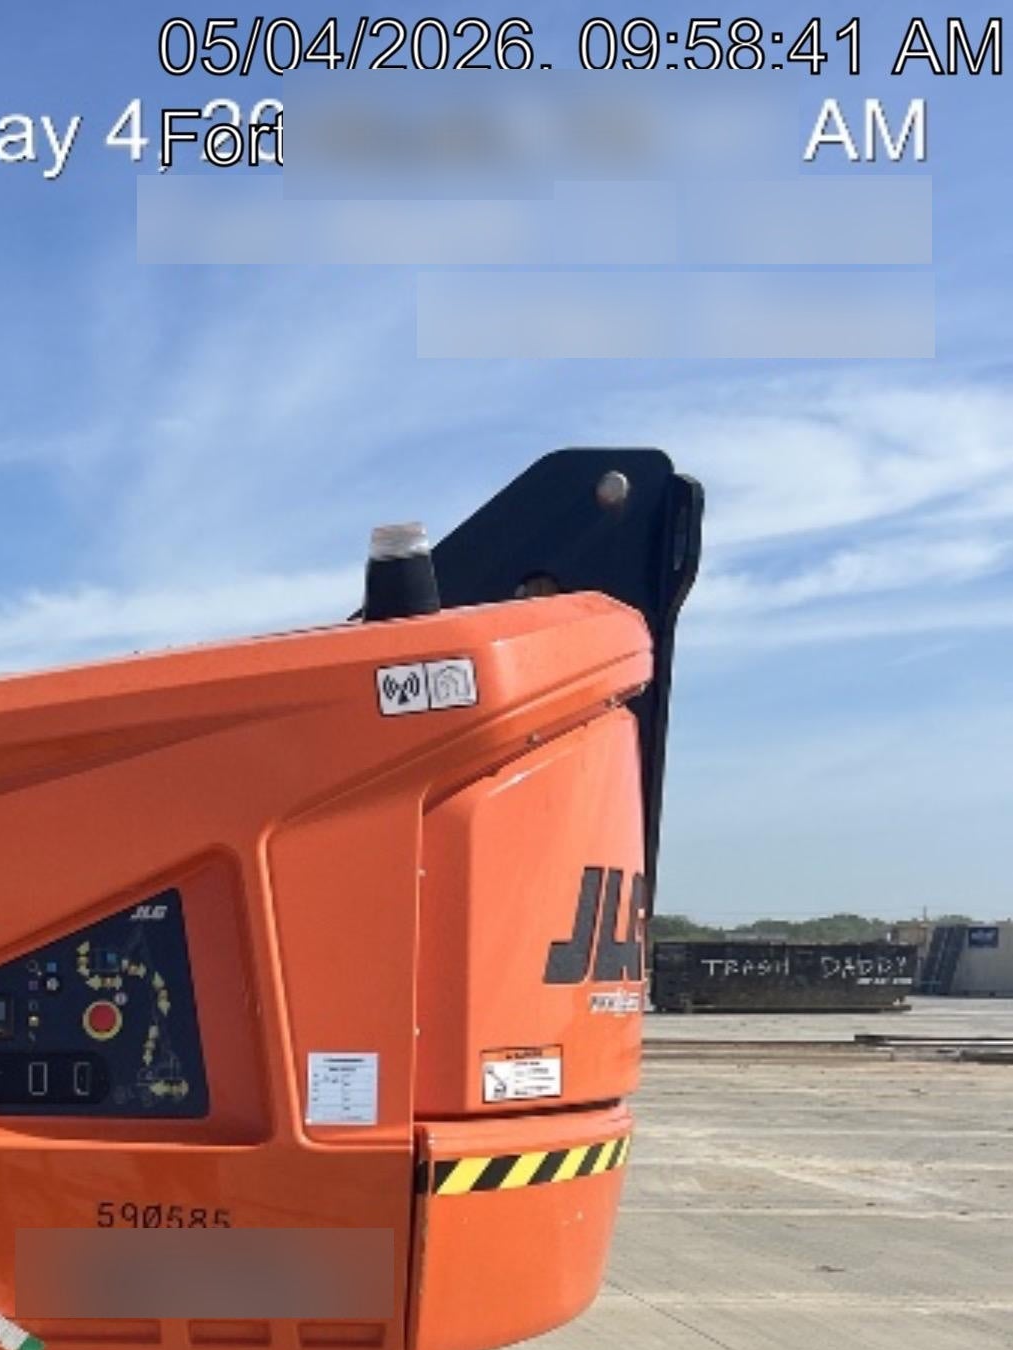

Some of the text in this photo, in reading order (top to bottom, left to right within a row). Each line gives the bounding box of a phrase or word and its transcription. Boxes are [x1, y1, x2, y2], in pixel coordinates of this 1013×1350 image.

[701, 955, 908, 978] TRASH DADDY
[96, 1202, 231, 1228] 590585
